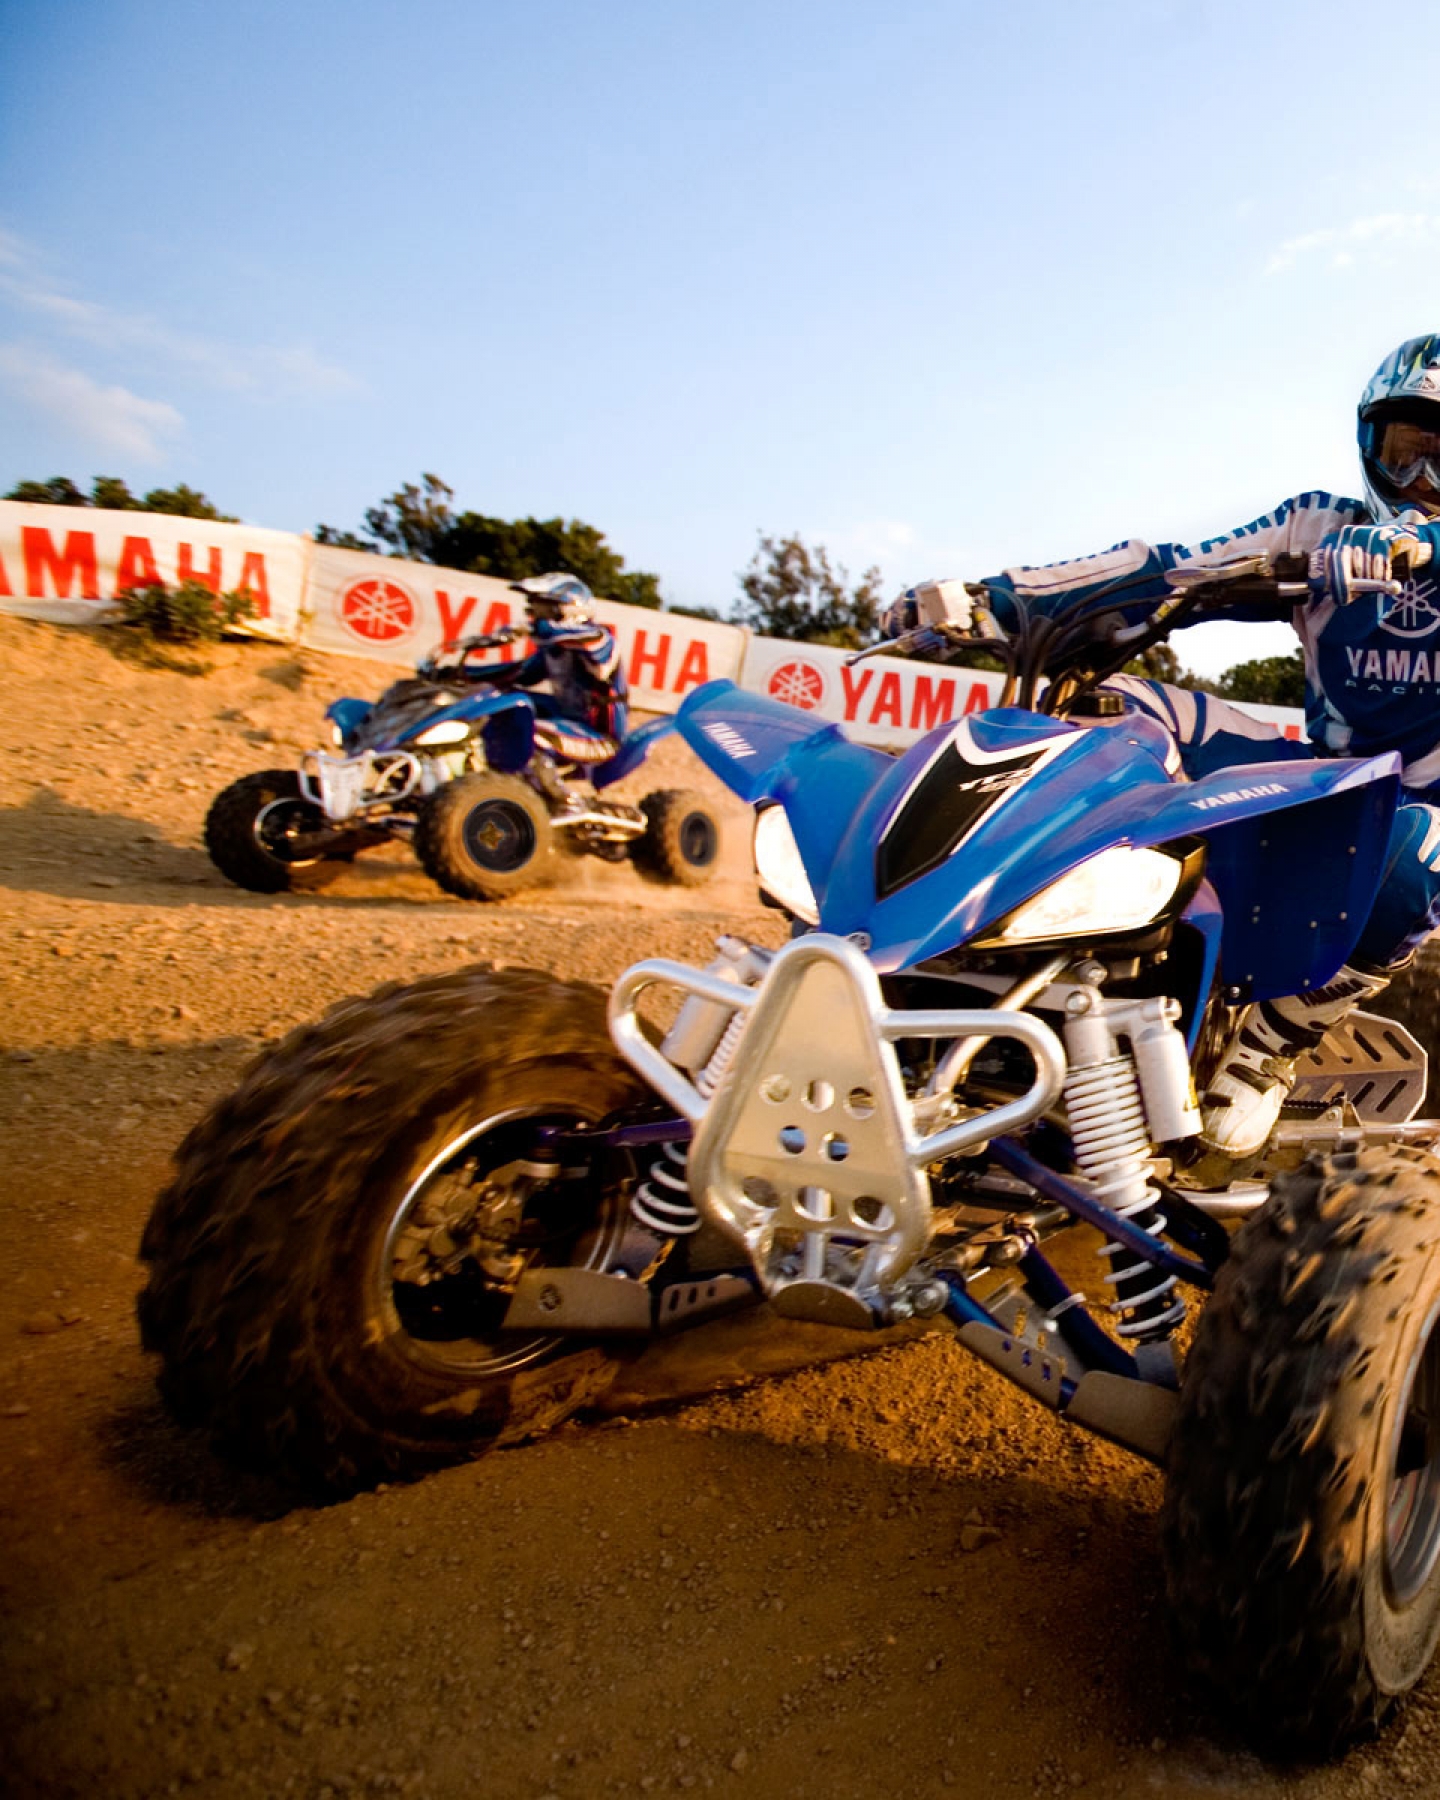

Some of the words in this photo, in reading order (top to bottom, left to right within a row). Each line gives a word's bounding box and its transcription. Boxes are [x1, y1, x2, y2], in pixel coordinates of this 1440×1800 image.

[0, 526, 271, 608] MAHA
[434, 590, 709, 693] YAHA
[840, 666, 991, 731] YAMA
[1188, 783, 1290, 810] YAMAHA
